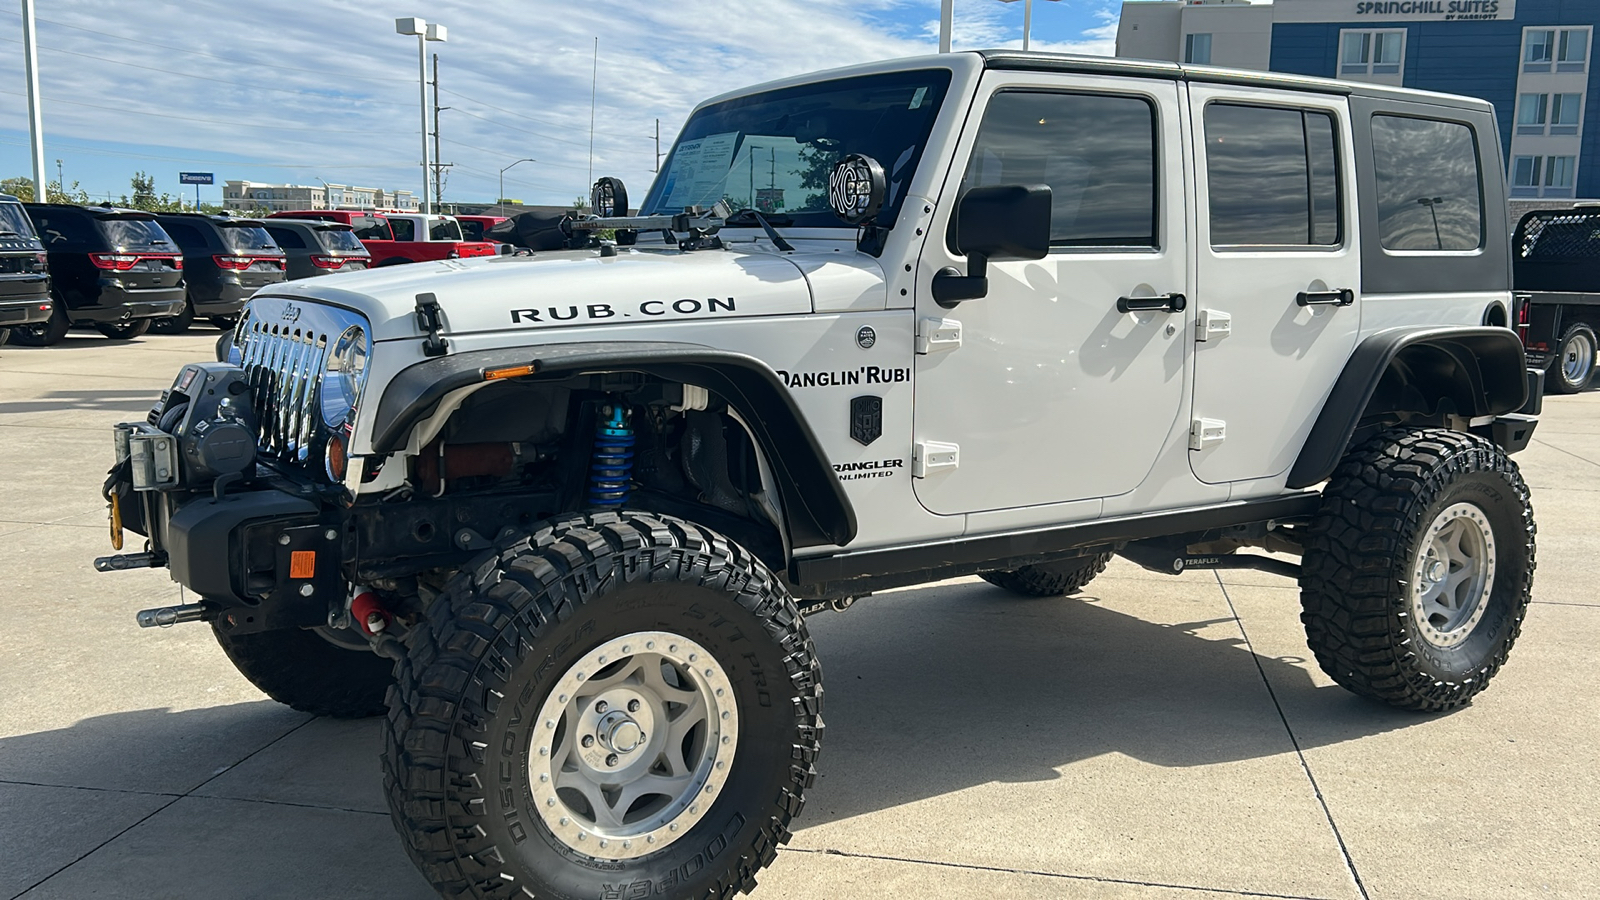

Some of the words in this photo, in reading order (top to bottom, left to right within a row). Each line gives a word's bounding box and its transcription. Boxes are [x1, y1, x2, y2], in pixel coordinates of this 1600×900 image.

[1356, 0, 1444, 14] SPRINGHILL
[1447, 0, 1499, 13] SUITES
[830, 163, 857, 213] KC
[510, 297, 736, 323] RUBCON
[832, 459, 903, 472] RANGLER
[838, 471, 893, 481] NLIMITED
[1185, 558, 1219, 566] TERAFLEX
[800, 601, 826, 614] FLEX
[498, 617, 597, 846] DISCOVERER
[599, 810, 747, 900] COOPER
